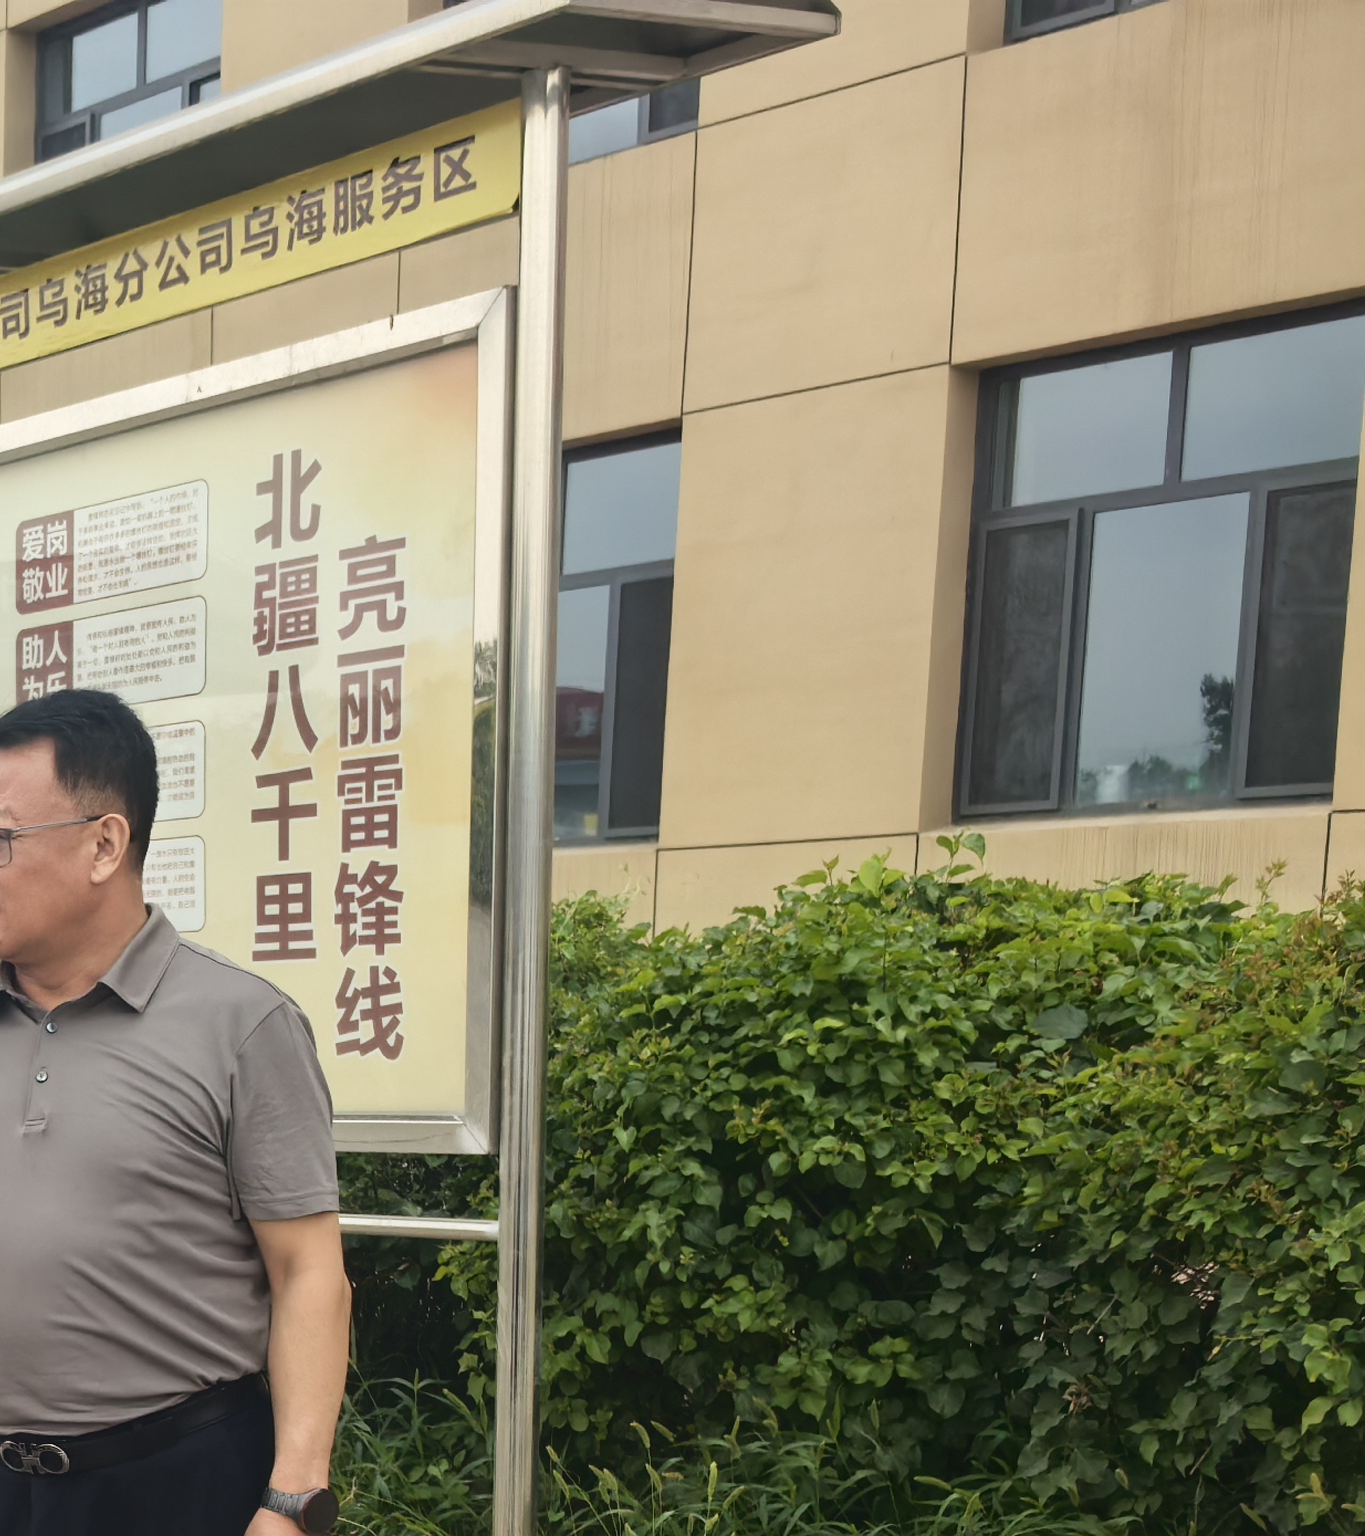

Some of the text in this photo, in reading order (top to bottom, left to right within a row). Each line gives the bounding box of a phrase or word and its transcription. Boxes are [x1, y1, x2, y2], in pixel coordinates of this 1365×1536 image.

[22, 519, 68, 562] 爱岗
[22, 562, 69, 604] 敬业
[22, 629, 68, 670] 助人
[251, 448, 322, 963] 北疆八千里
[334, 535, 406, 1061] 亮丽雷锋线
